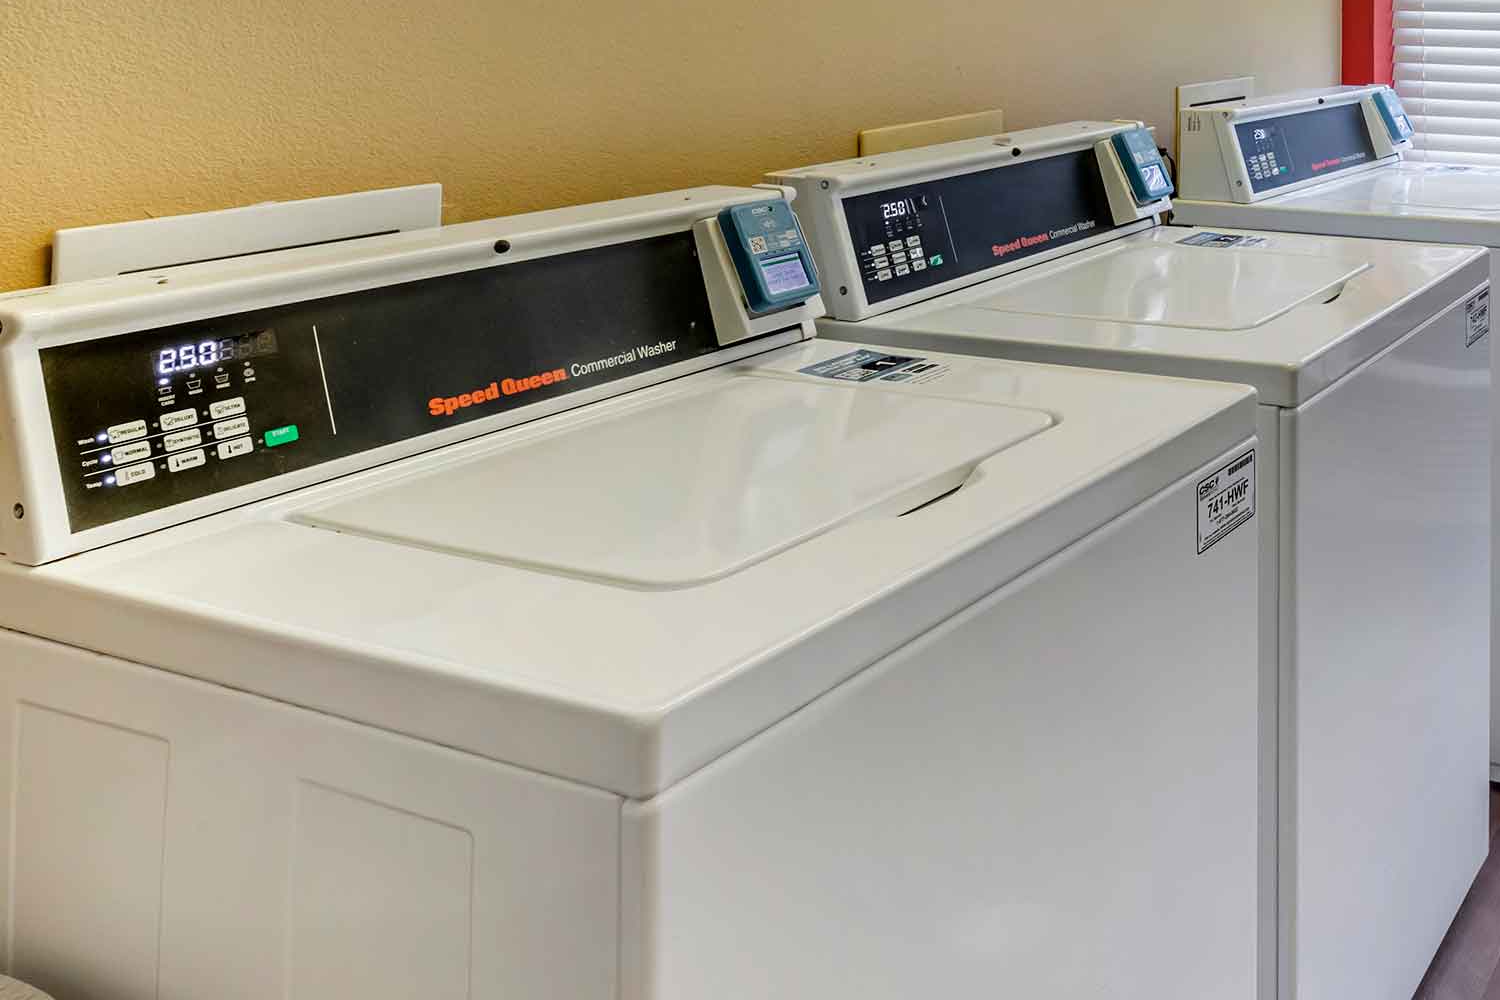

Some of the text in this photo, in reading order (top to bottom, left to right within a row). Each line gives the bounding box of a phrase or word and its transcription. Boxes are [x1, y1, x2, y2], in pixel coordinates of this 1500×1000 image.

[428, 339, 677, 416] Speed Queen Commercial Washer
[1207, 479, 1249, 519] 741-HWF
